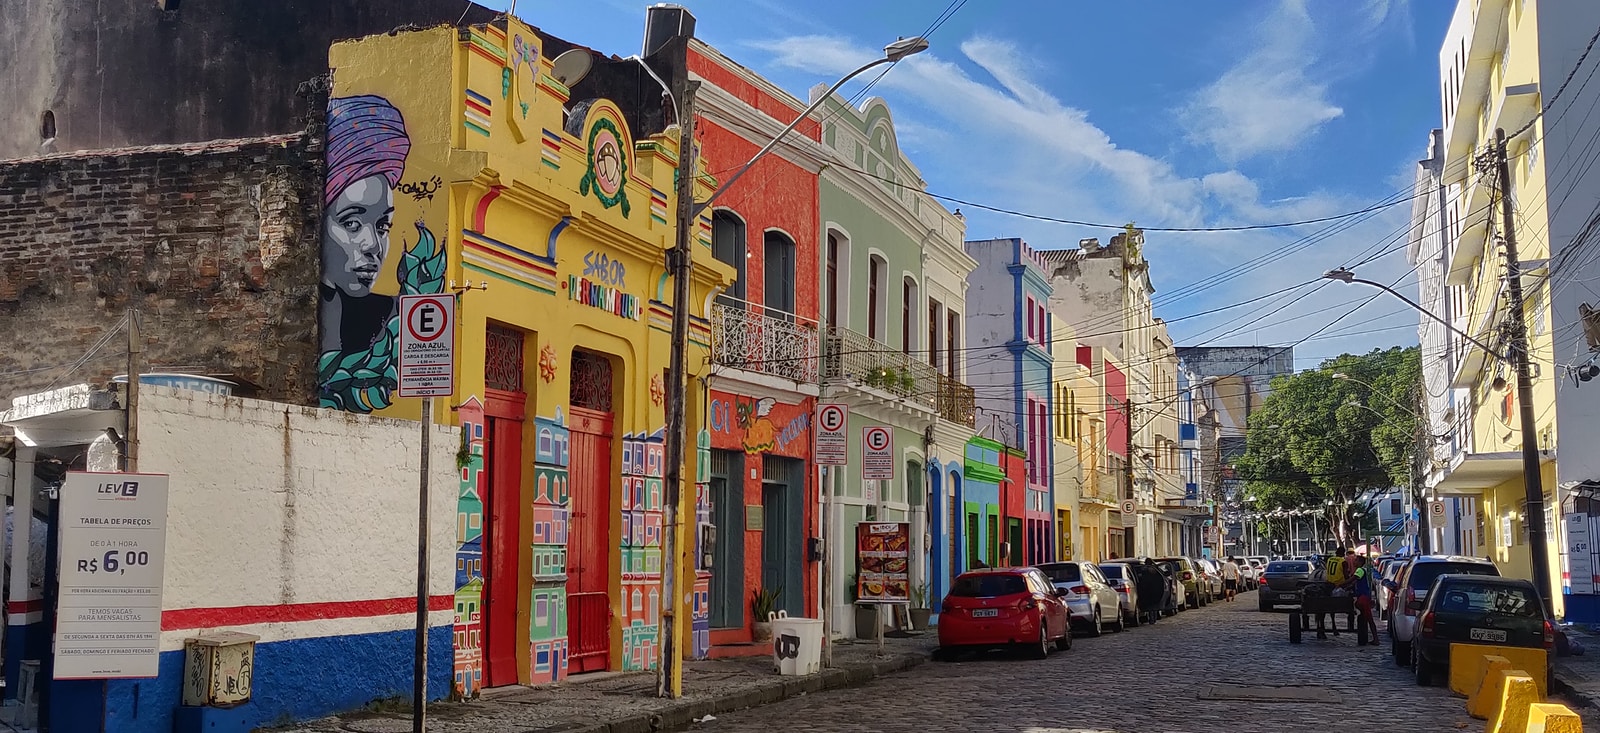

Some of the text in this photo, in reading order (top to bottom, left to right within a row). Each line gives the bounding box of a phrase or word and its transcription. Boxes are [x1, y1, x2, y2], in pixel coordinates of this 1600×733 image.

[583, 250, 626, 289] SABOR
[568, 273, 640, 322] PERNAMBUCO
[421, 308, 434, 332] E
[828, 412, 836, 426] E
[874, 433, 882, 446] E
[98, 482, 138, 496] LEVE
[78, 550, 148, 576] R$ 6,00
[1329, 561, 1338, 575] 10
